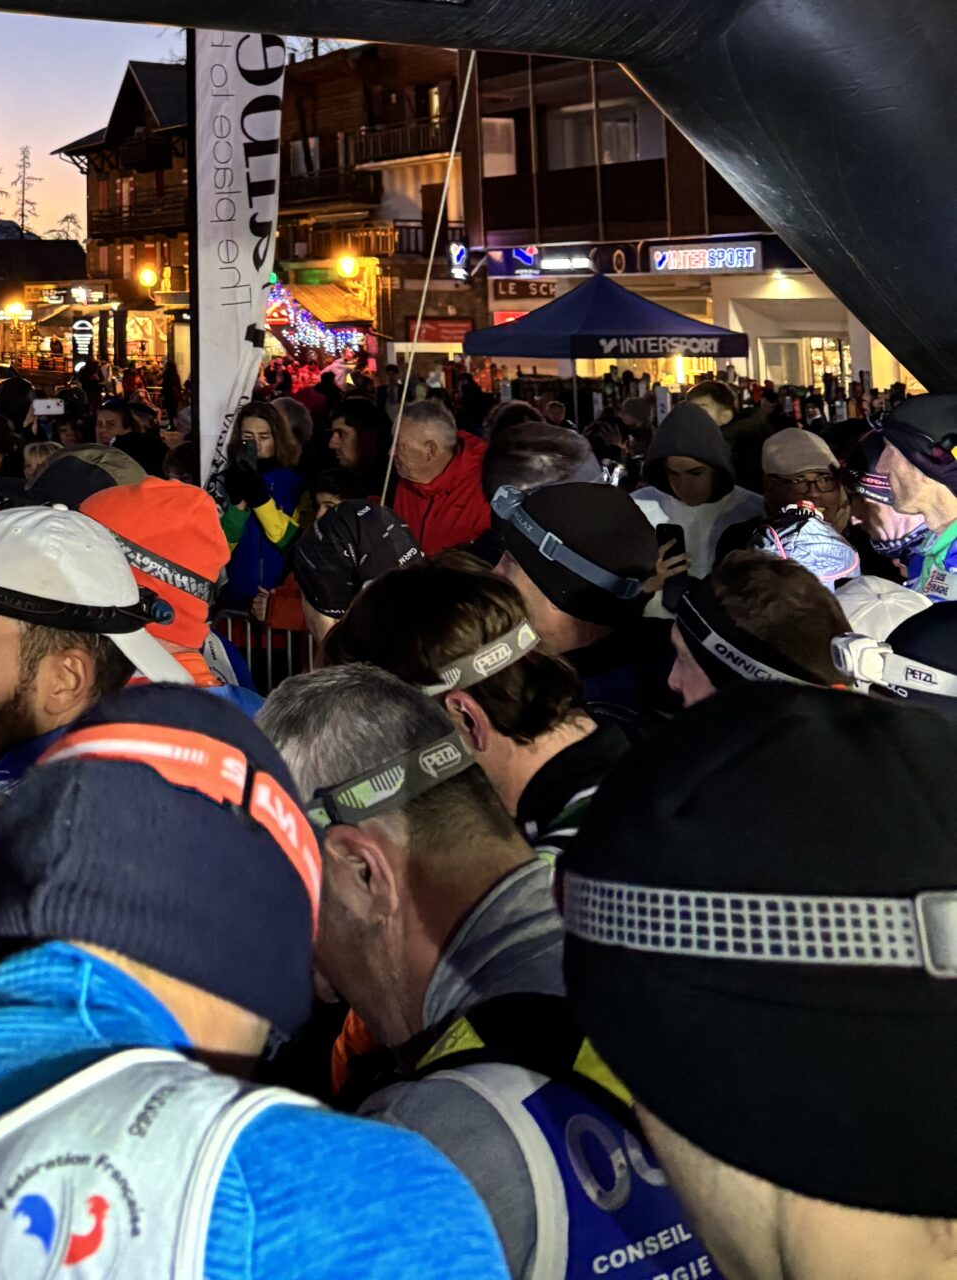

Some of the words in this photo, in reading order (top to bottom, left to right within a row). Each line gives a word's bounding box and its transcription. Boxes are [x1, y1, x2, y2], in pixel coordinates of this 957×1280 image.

[668, 247, 755, 270] INTERSPORT
[499, 283, 517, 295] LE
[620, 336, 720, 354] INTERSPORT
[474, 642, 512, 675] PETZL
[906, 666, 938, 685] PETZL
[421, 742, 461, 777] PETZL
[592, 1223, 693, 1274] CONSEIL
